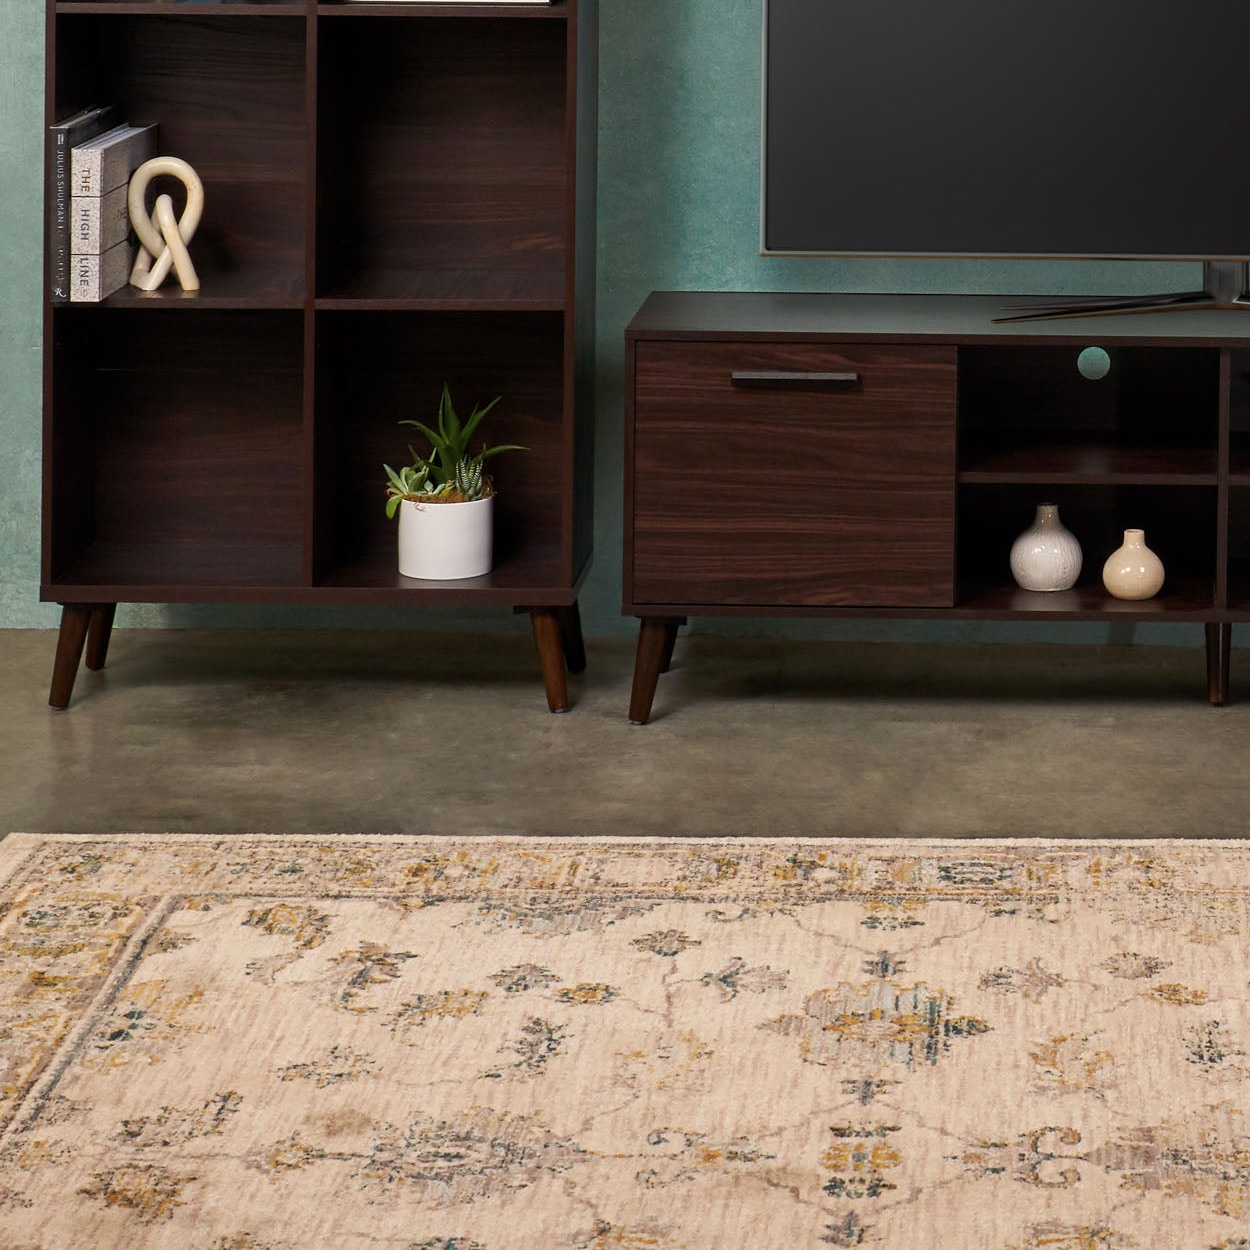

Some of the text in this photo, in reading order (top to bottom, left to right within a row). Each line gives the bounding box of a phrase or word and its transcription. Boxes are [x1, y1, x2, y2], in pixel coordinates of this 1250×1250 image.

[56, 150, 65, 180] JULIUS
[80, 167, 91, 192] THE
[56, 181, 65, 223] SHULMAN
[80, 209, 90, 241] HIGH
[80, 257, 90, 287] LINE
